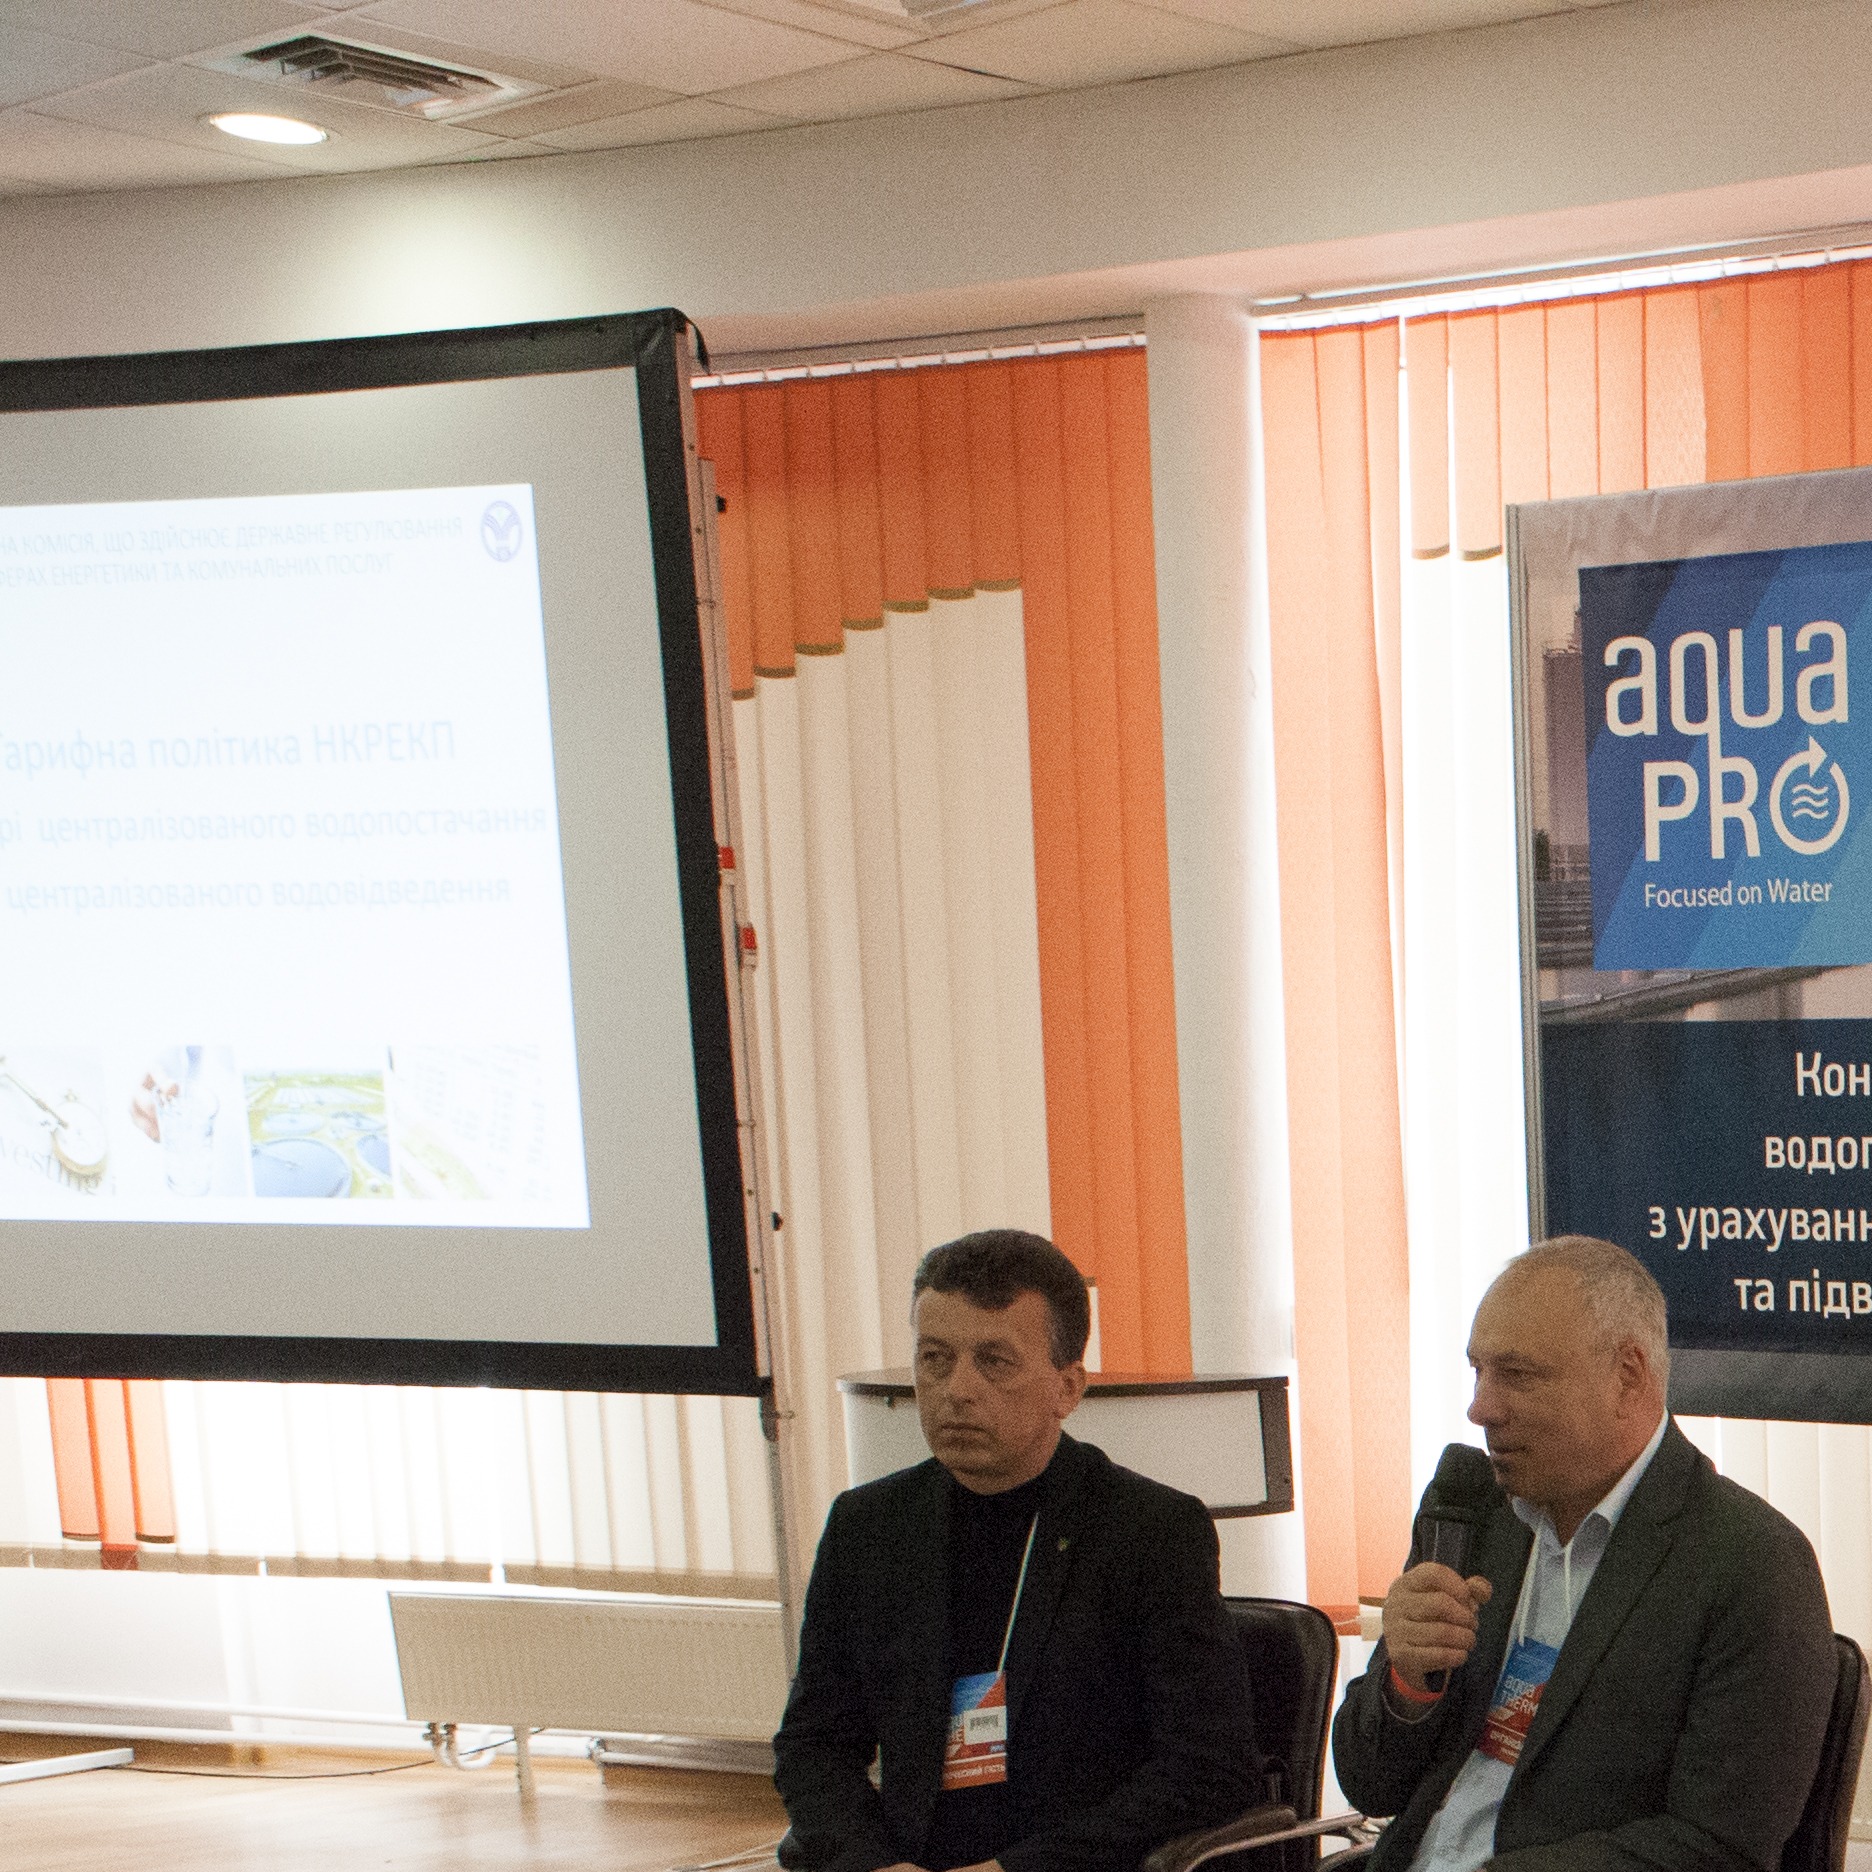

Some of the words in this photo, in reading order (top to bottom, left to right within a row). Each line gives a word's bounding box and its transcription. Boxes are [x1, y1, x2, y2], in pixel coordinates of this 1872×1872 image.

[1603, 619, 1850, 745] aqua
[0, 727, 138, 781] арифна
[146, 726, 302, 769] політика
[311, 719, 456, 764] НКРЕКП
[37, 807, 297, 848] централізованого
[305, 806, 548, 844] водопостачання
[5, 876, 263, 916] централізованого
[271, 873, 511, 912] водовідведення
[1644, 880, 1733, 908] Focused
[1737, 886, 1763, 906] on
[1767, 878, 1833, 903] Water
[1648, 1205, 1667, 1239] з
[1733, 1276, 1776, 1312] та
